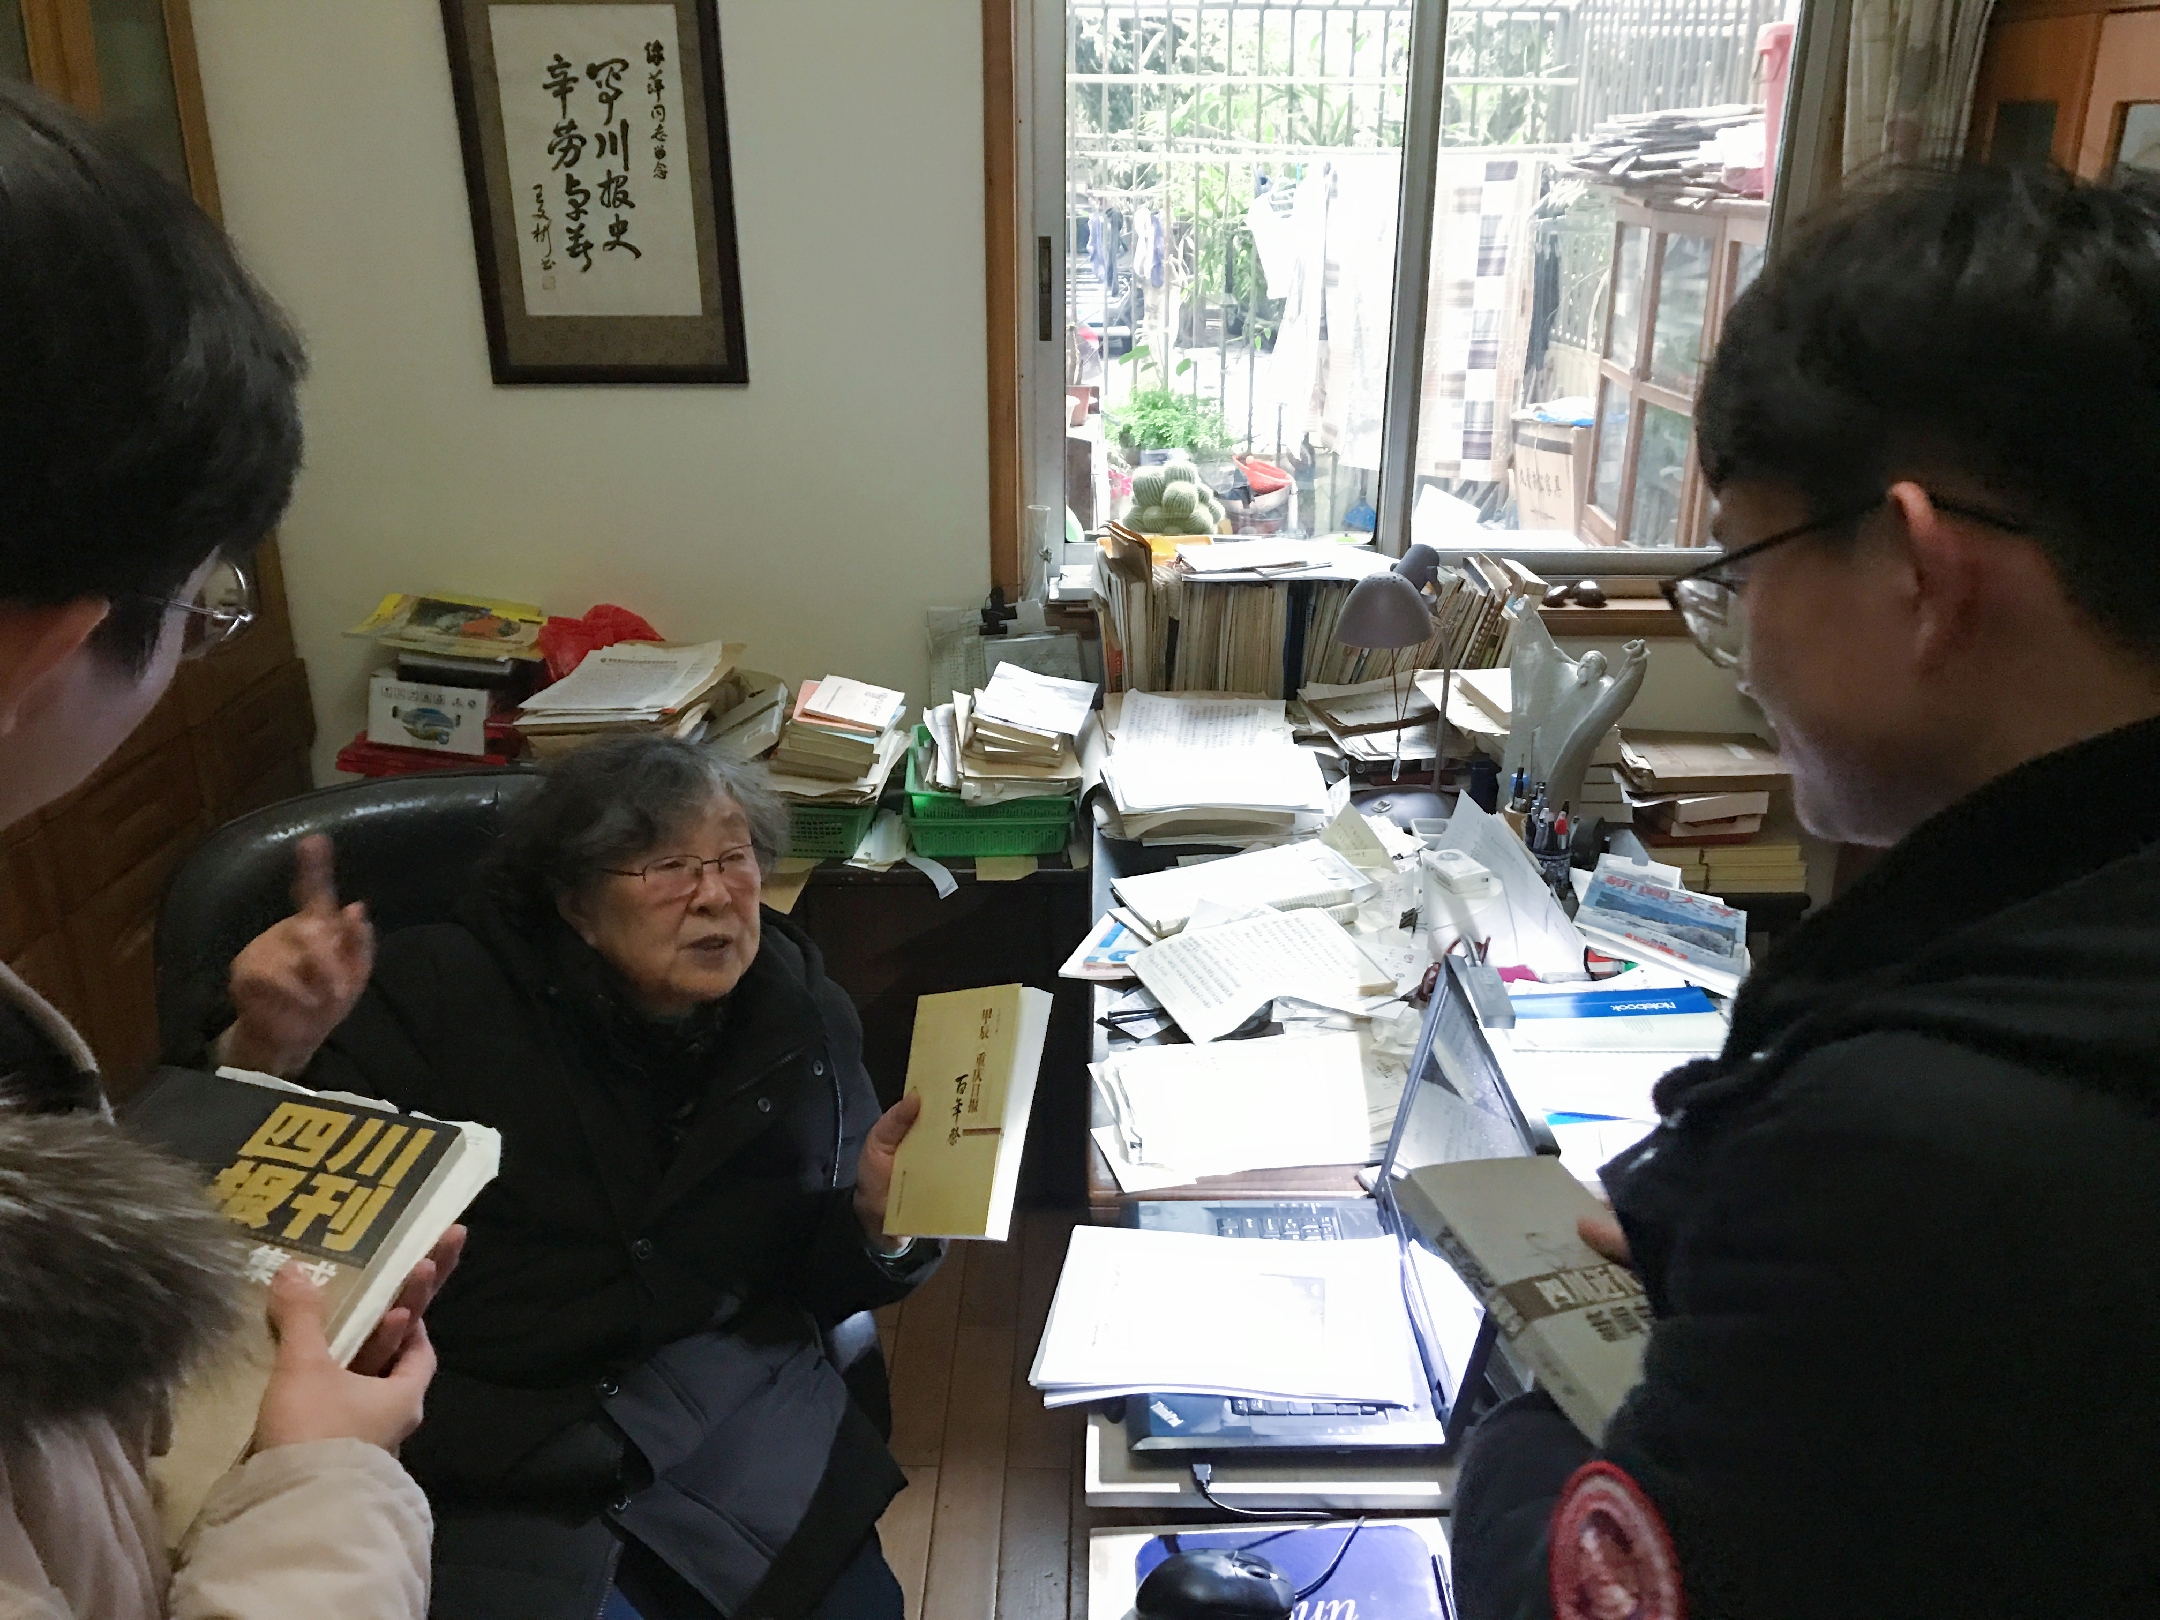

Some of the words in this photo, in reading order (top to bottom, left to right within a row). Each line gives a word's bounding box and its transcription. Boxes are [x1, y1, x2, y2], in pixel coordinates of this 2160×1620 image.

[1609, 1001, 1677, 1012] Notebook
[238, 1101, 437, 1186] 四川
[208, 1158, 395, 1252] 报刊
